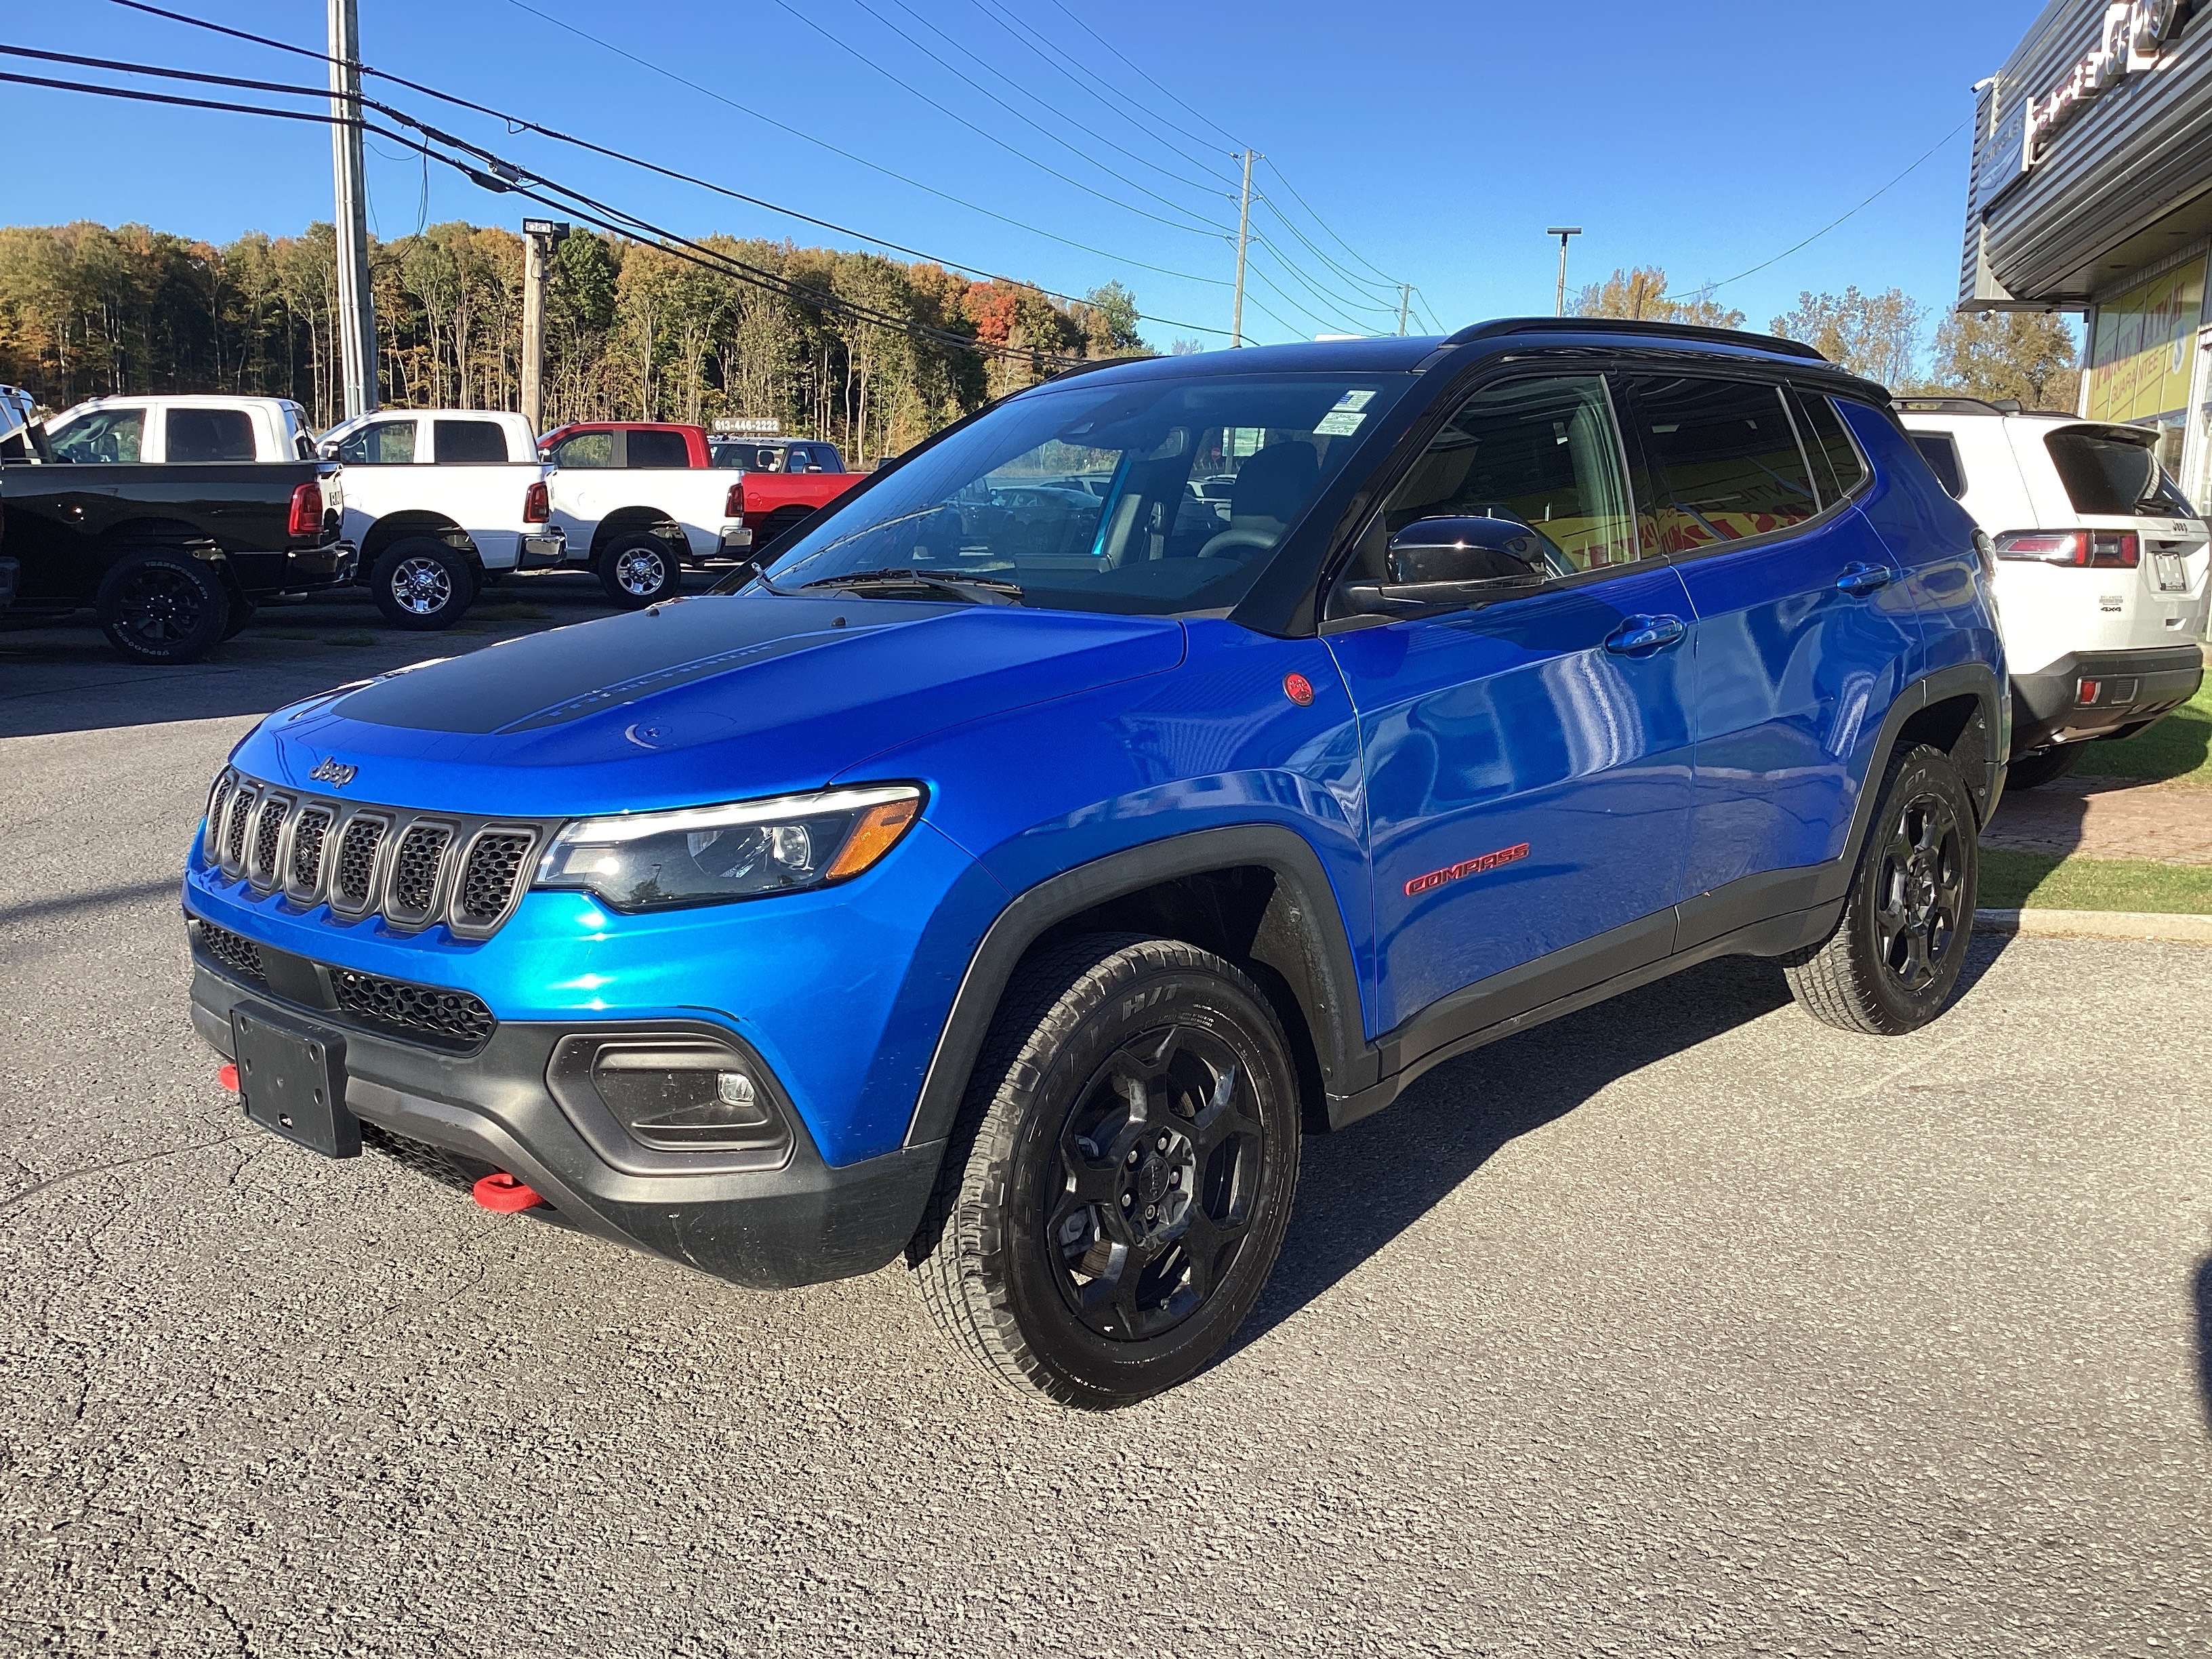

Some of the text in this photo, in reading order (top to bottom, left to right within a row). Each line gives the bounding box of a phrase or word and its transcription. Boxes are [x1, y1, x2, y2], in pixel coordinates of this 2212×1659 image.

[2111, 350, 2159, 405] GUARANTEE
[714, 419, 778, 431] 613-446-2222
[309, 755, 359, 790] Jeep
[1405, 842, 1530, 897] COMPASS
[1122, 983, 1182, 1021] H/T
